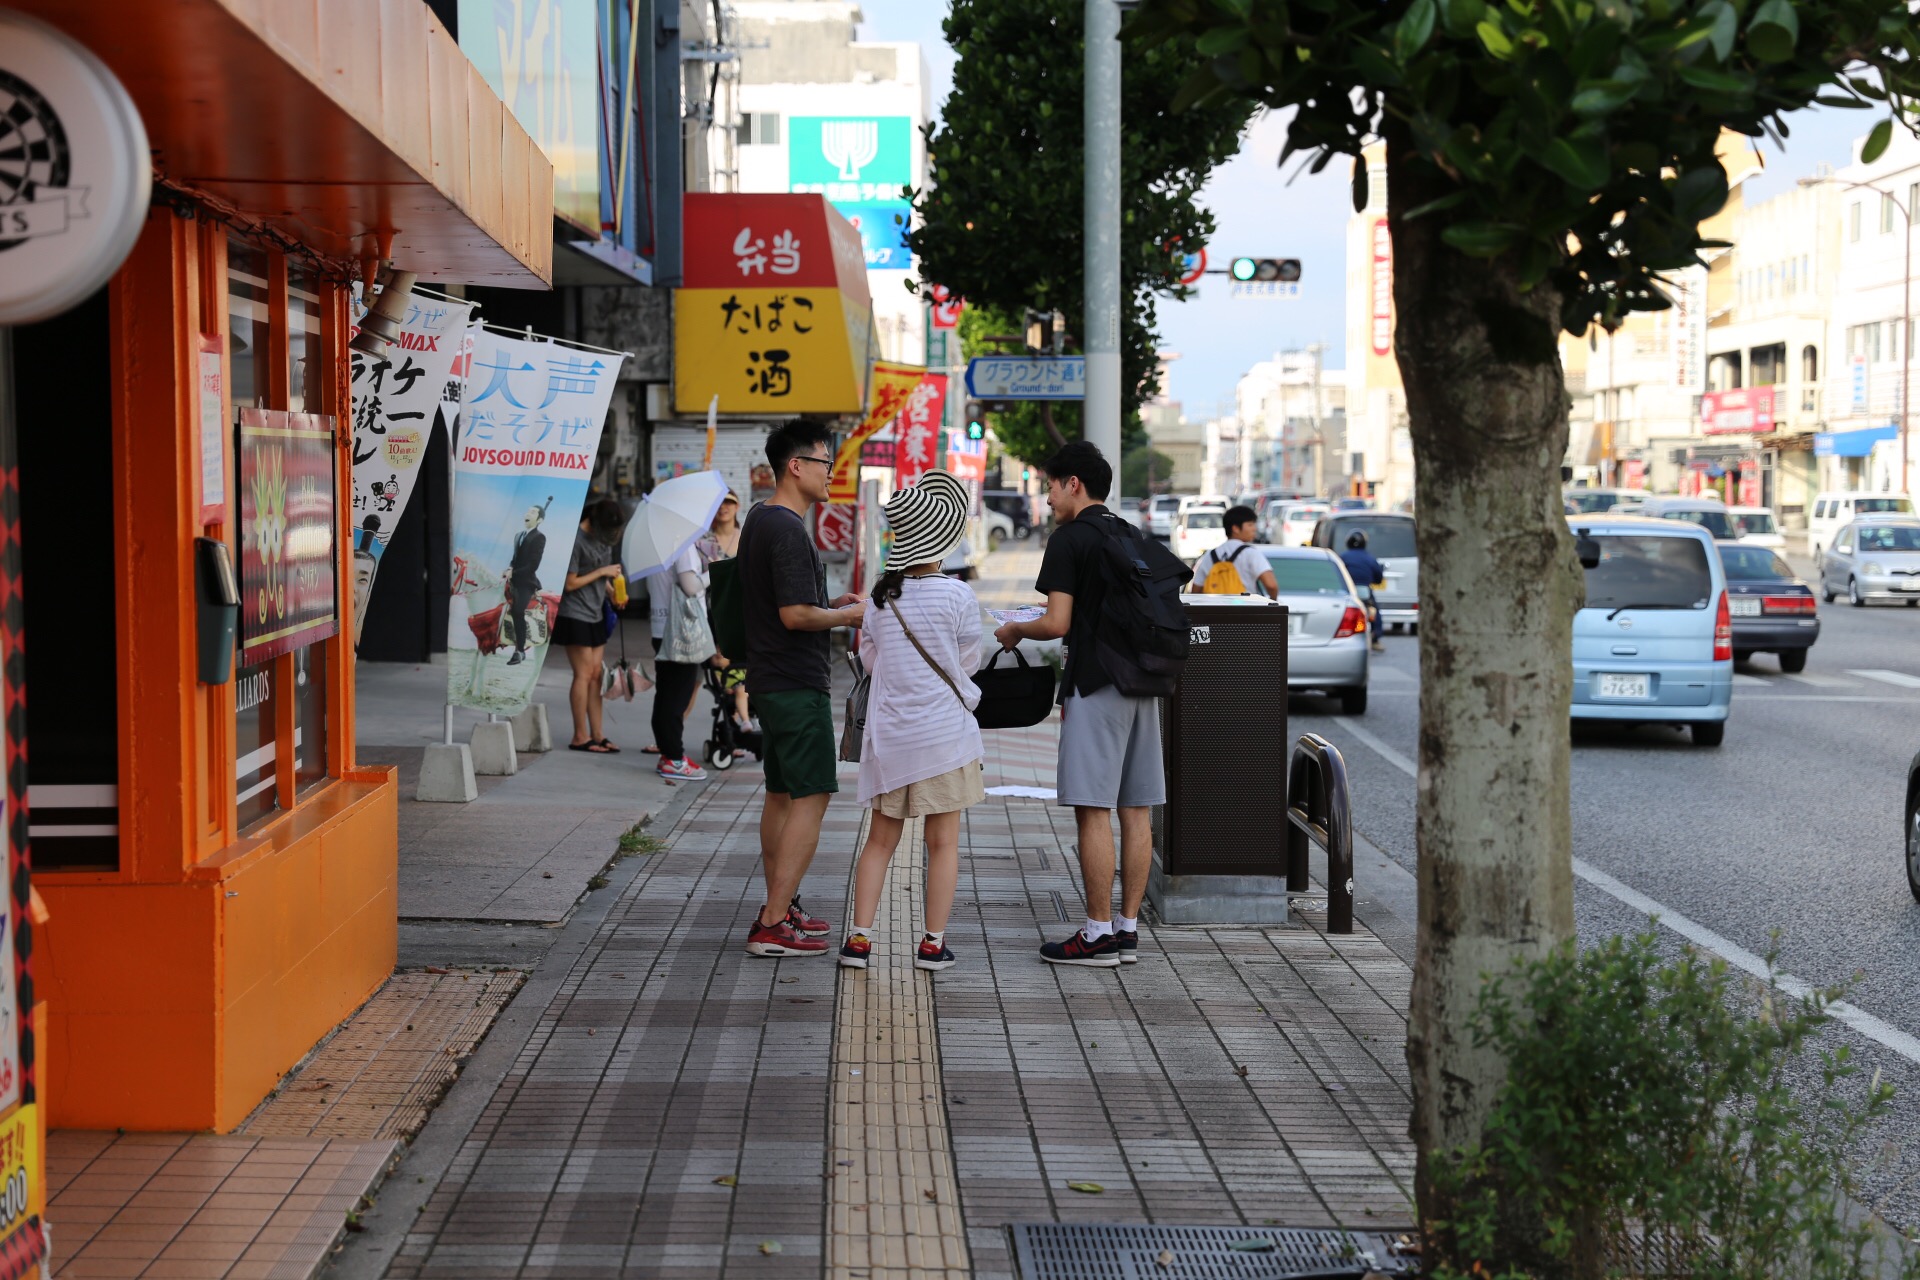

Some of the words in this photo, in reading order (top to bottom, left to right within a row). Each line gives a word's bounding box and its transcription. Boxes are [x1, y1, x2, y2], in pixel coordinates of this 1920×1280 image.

[733, 227, 800, 276] 弁当
[721, 295, 813, 334] たばこ
[469, 349, 606, 410] 大声
[746, 349, 790, 397] 酒
[462, 447, 545, 466] JOYSOUND
[549, 452, 589, 470] MAX
